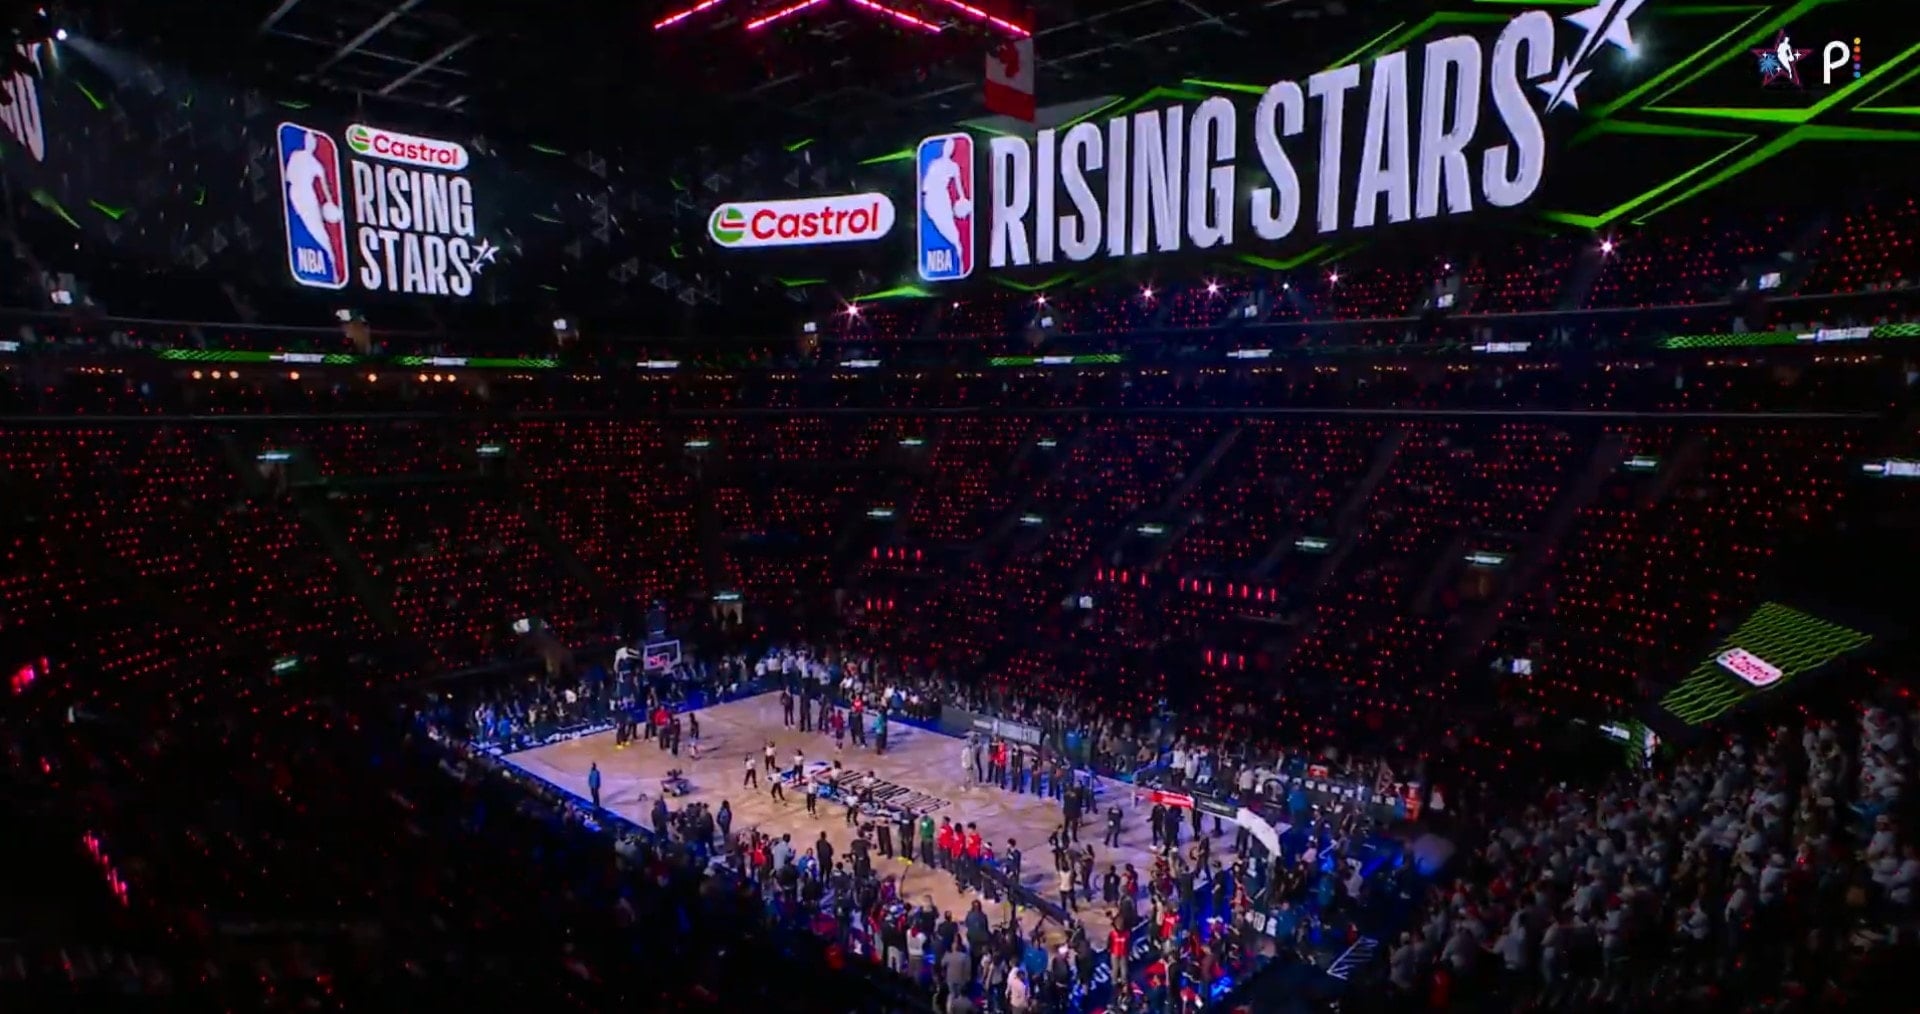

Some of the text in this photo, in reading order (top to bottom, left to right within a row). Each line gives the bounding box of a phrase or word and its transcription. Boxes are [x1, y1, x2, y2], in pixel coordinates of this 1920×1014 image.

[373, 134, 459, 166] Castrol
[989, 10, 1556, 268] RISING STARS
[352, 160, 475, 238] RISING
[751, 202, 879, 240] Castrol
[297, 247, 327, 275] NBA
[358, 226, 473, 297] STARS
[927, 248, 952, 272] NBA
